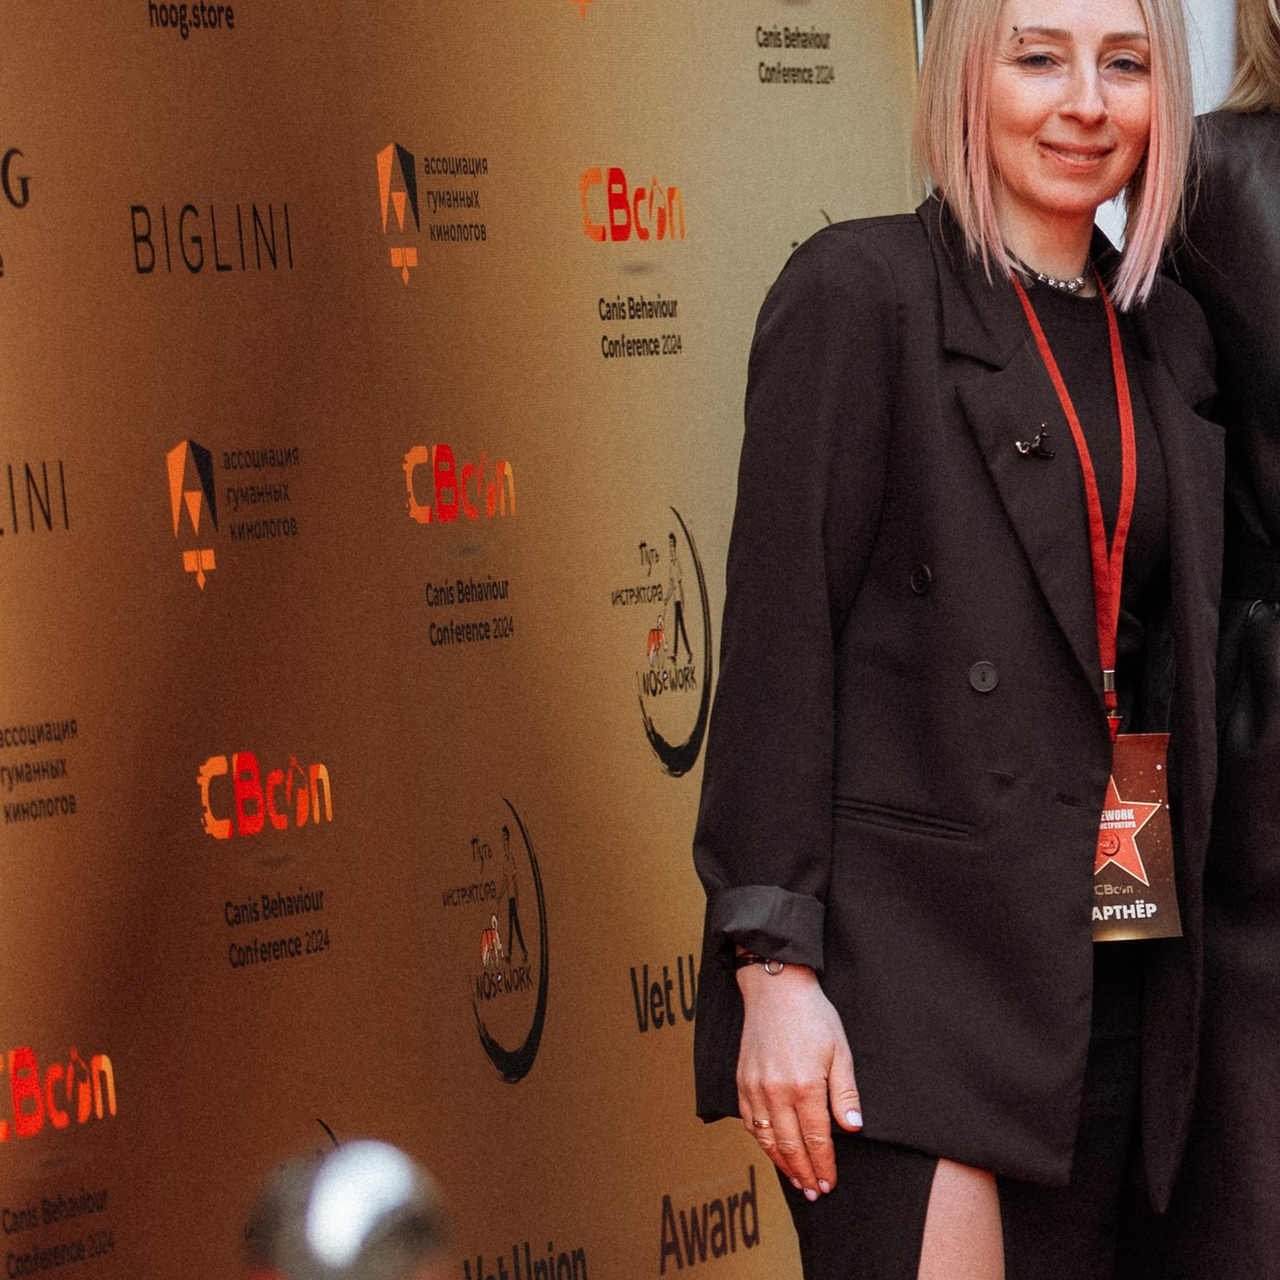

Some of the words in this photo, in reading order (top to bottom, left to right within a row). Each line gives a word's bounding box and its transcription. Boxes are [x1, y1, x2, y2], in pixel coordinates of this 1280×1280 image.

[756, 24, 783, 49] Canis
[784, 25, 831, 50] Behaviour
[758, 61, 814, 85] Conference
[423, 156, 489, 179] ассоциация
[426, 189, 481, 214] гуманных
[130, 204, 294, 275] BIGLINI
[429, 223, 487, 242] кинологов
[598, 294, 627, 321] Canis
[628, 293, 678, 320] Behaviour
[601, 333, 660, 359] Conference
[662, 335, 683, 355] 2024
[223, 446, 300, 471] ассоциация
[226, 483, 291, 511] гуманных
[230, 516, 298, 542] кинологов
[425, 579, 455, 608] Canis
[456, 574, 510, 604] Behaviour
[429, 618, 491, 648] Conference
[493, 616, 515, 640] 2024
[3, 794, 78, 824] кинологов
[224, 897, 260, 927] Canis
[261, 886, 326, 921] Behaviour
[1091, 899, 1158, 922] АРТНЁР
[228, 933, 302, 969] Conference
[304, 928, 331, 954] 2024
[630, 964, 676, 1034] Vet
[660, 1163, 760, 1275] Award
